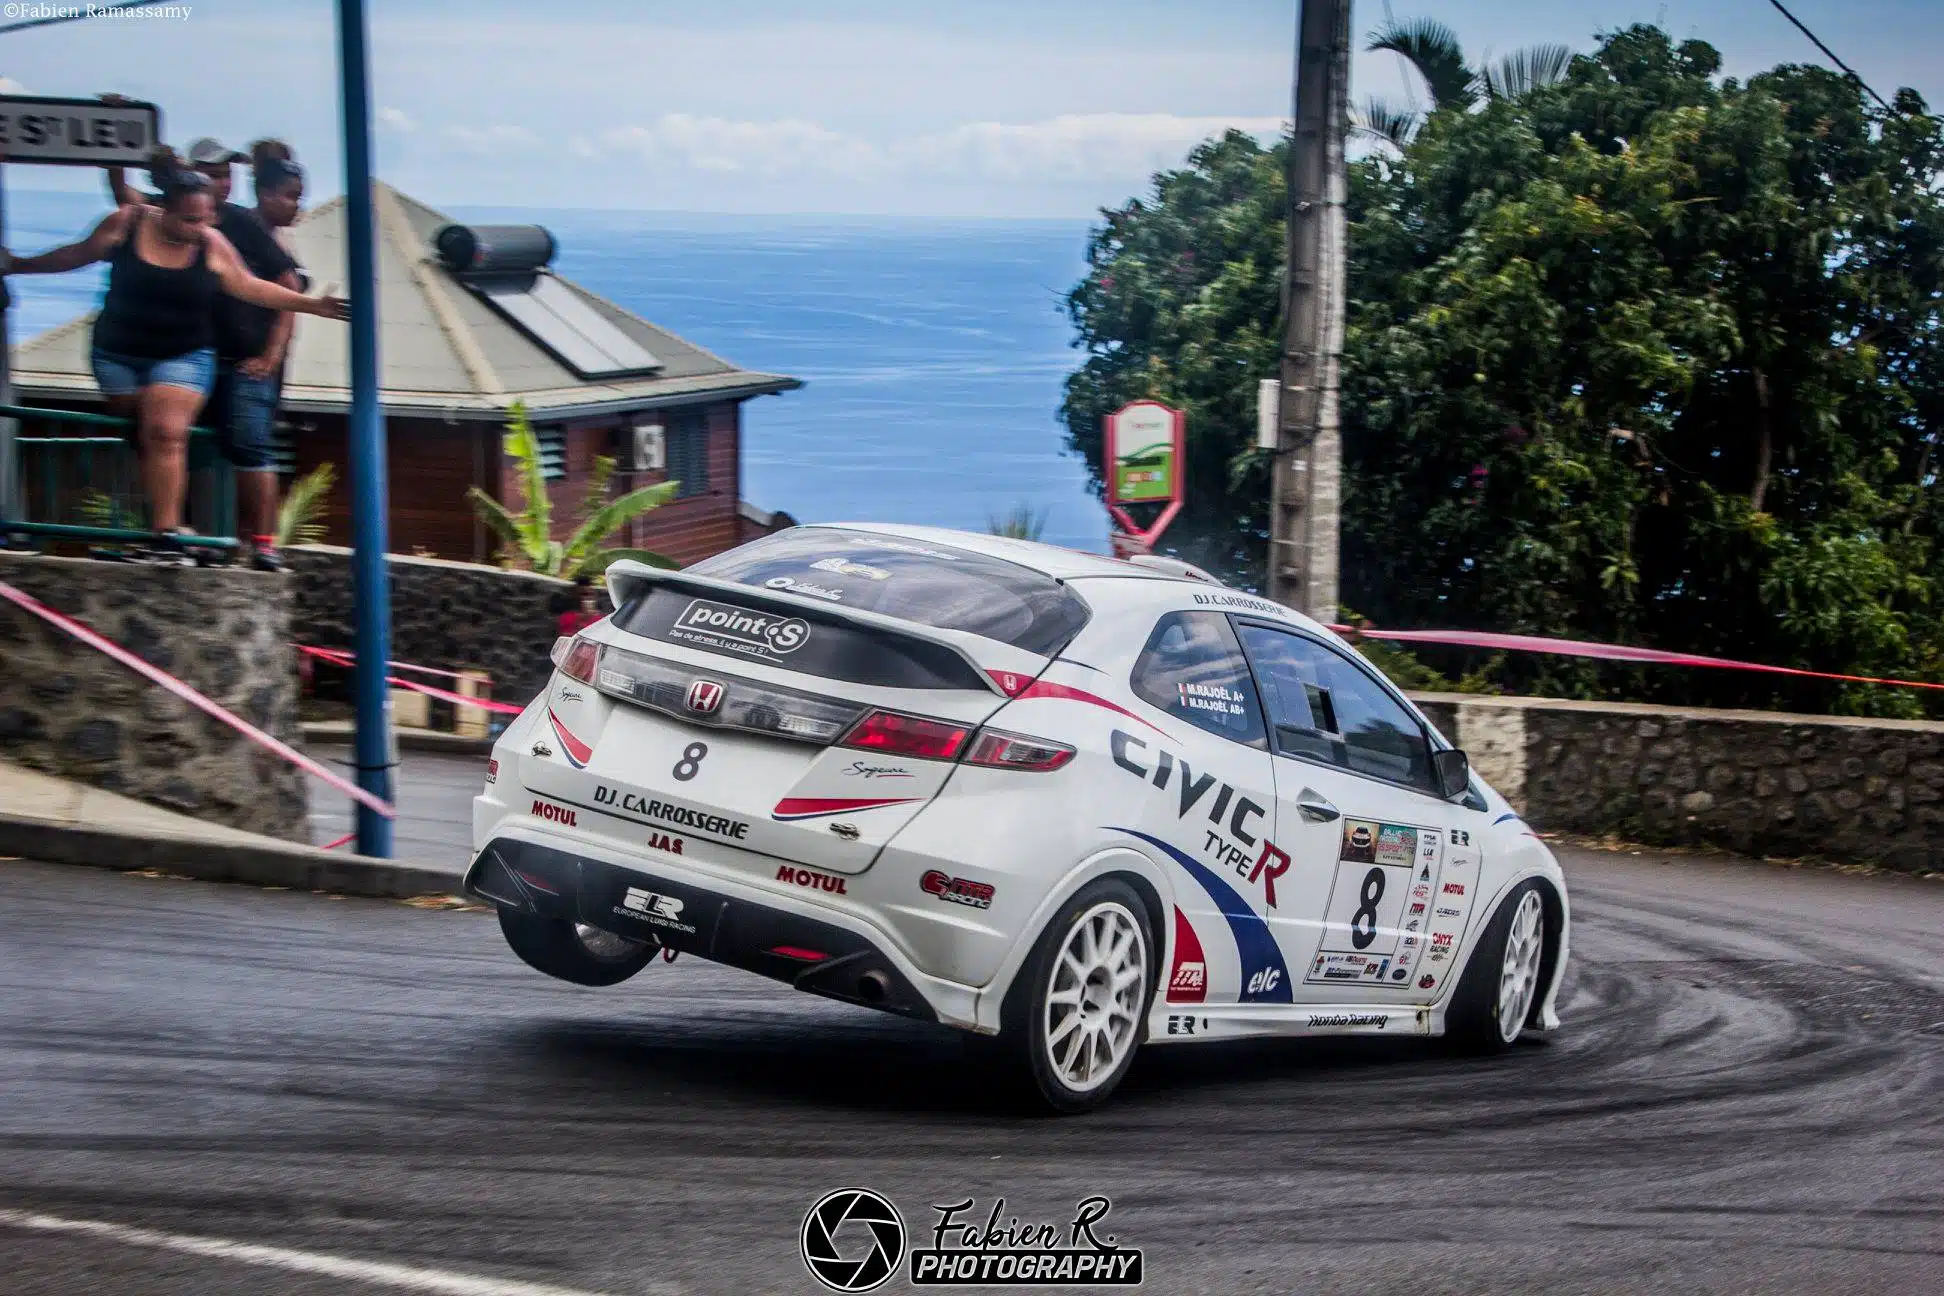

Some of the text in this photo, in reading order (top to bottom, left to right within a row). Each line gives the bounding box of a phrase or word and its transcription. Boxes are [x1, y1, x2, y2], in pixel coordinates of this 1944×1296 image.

[688, 608, 767, 635] point
[1233, 691, 1245, 702] A+
[672, 741, 708, 781] 8
[1110, 729, 1266, 848] CIVIC
[531, 800, 577, 828] MOTUL
[647, 832, 684, 855] JAS
[776, 865, 848, 895] MOTUL
[1203, 829, 1292, 909] TYPE R
[1443, 883, 1465, 896] MOTUL
[612, 905, 649, 922] EUROPEAN
[1350, 867, 1386, 950] 8
[1432, 932, 1454, 946] ONYX
[1307, 1013, 1389, 1029] Honda Racing
